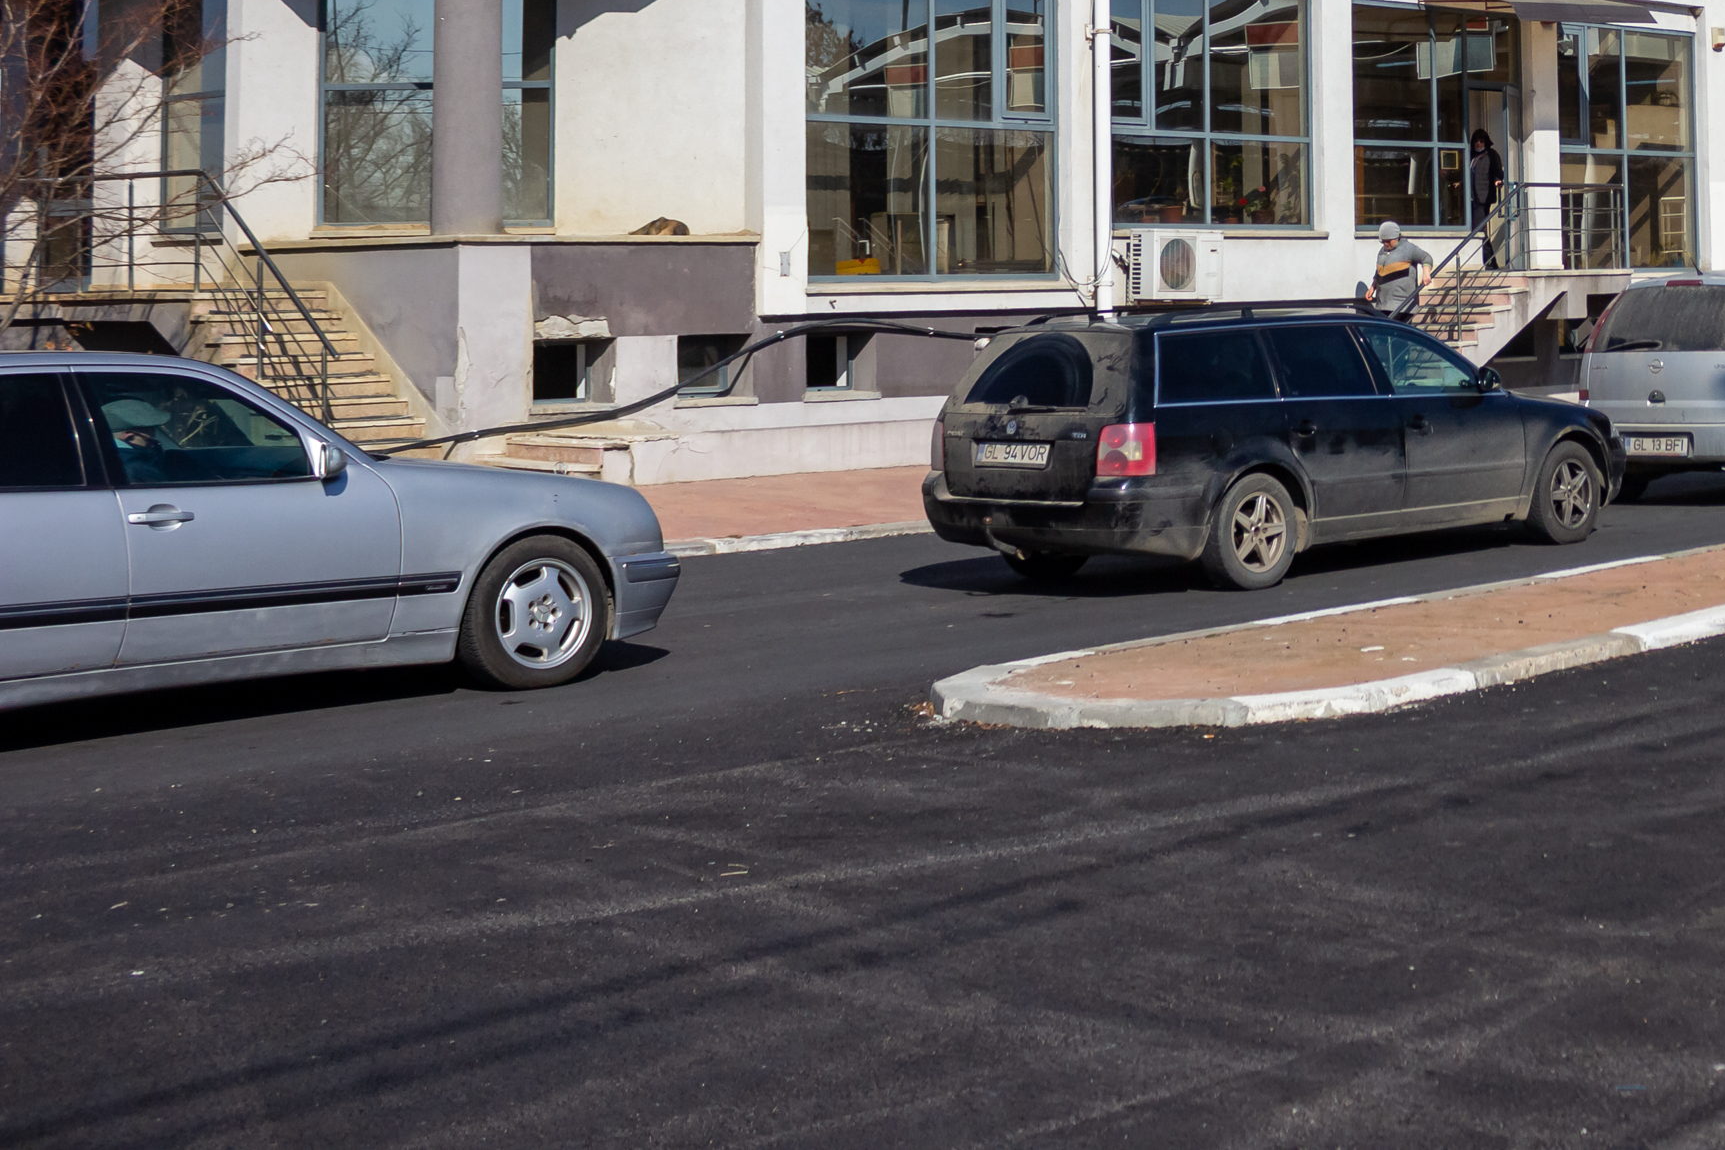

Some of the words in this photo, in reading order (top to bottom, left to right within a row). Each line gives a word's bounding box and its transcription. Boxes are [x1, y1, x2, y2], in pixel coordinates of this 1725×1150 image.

[1633, 439, 1647, 451] GL
[1652, 439, 1661, 451] 13
[1665, 439, 1684, 452] BFI
